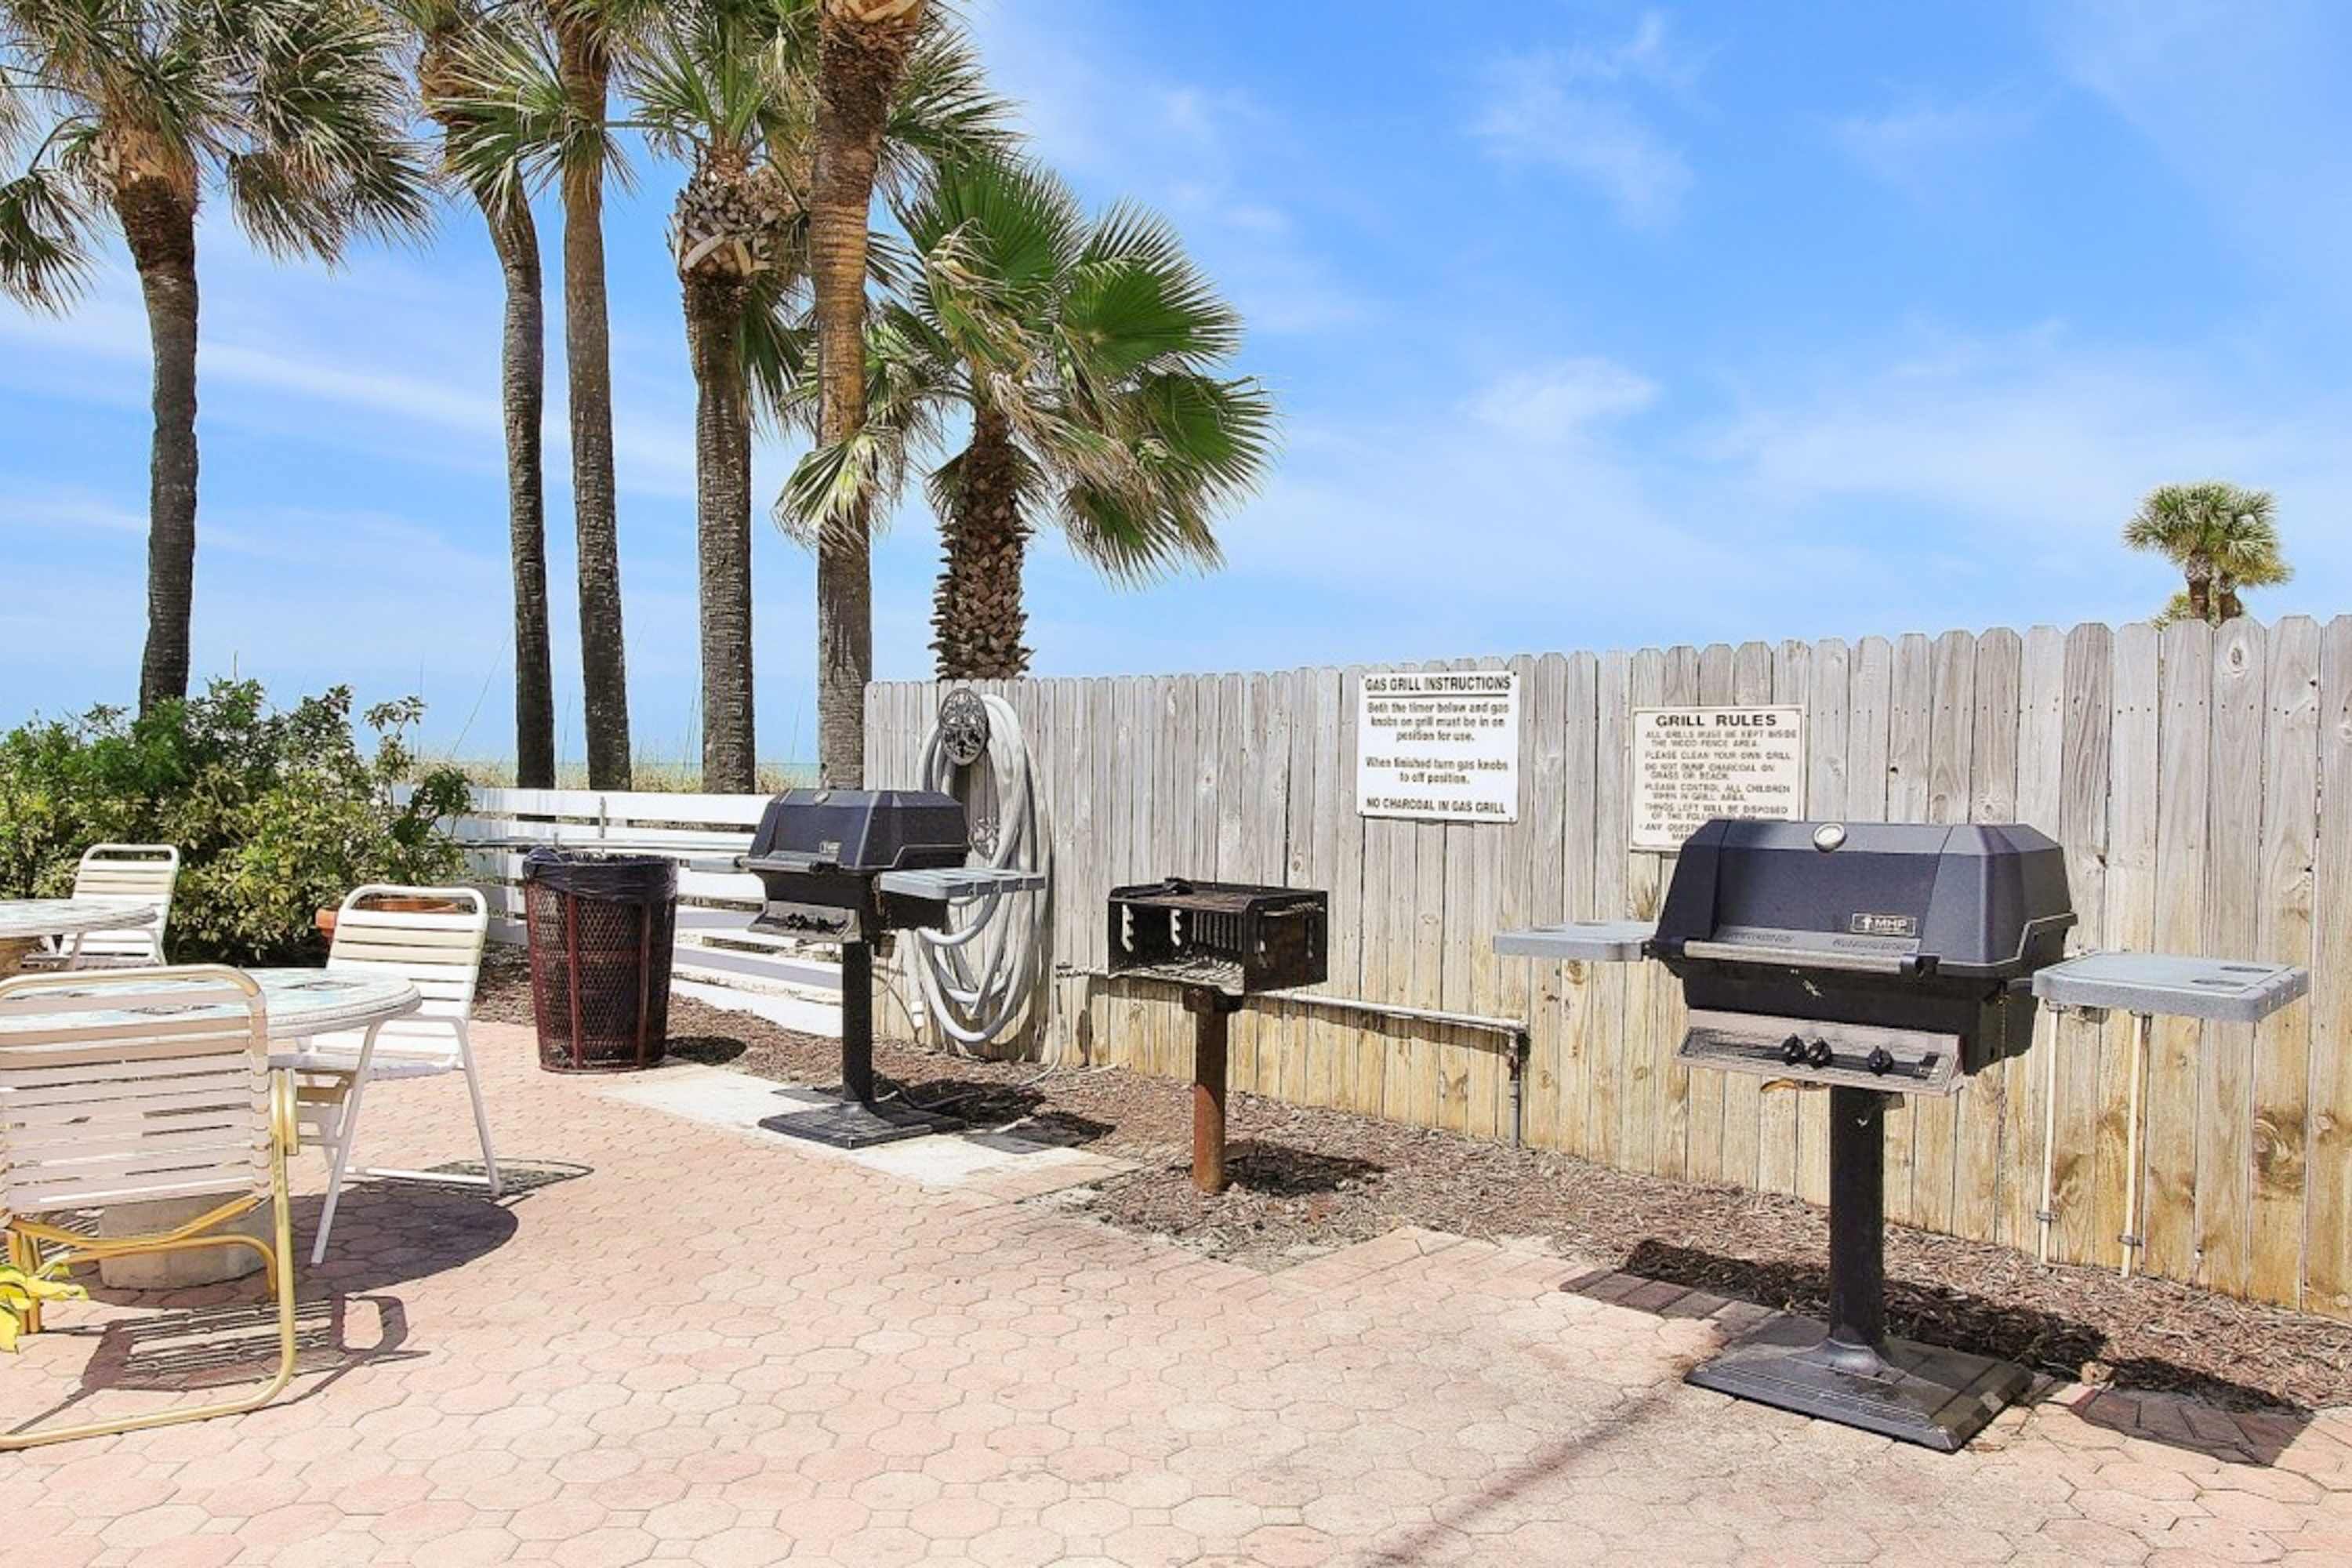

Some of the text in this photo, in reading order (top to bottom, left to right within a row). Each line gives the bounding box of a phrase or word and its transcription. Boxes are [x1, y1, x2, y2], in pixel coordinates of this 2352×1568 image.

[1365, 677, 1511, 691] GAS GRILL INSTRUCTIONS
[1367, 702, 1509, 714] Both the timer below and gas
[1371, 717, 1397, 726] knobs
[1416, 717, 1433, 728] grill
[1464, 717, 1476, 726] be
[1480, 717, 1489, 726] in
[1656, 714, 1777, 727] GRILL RULES
[1396, 731, 1475, 742] position for use.
[1366, 757, 1508, 771] When finished turn gas knobs
[1400, 772, 1470, 785] to off position.
[1367, 797, 1505, 814] NO CHARCOAL IN GAS GRILL
[1875, 918, 1907, 930] MHP
